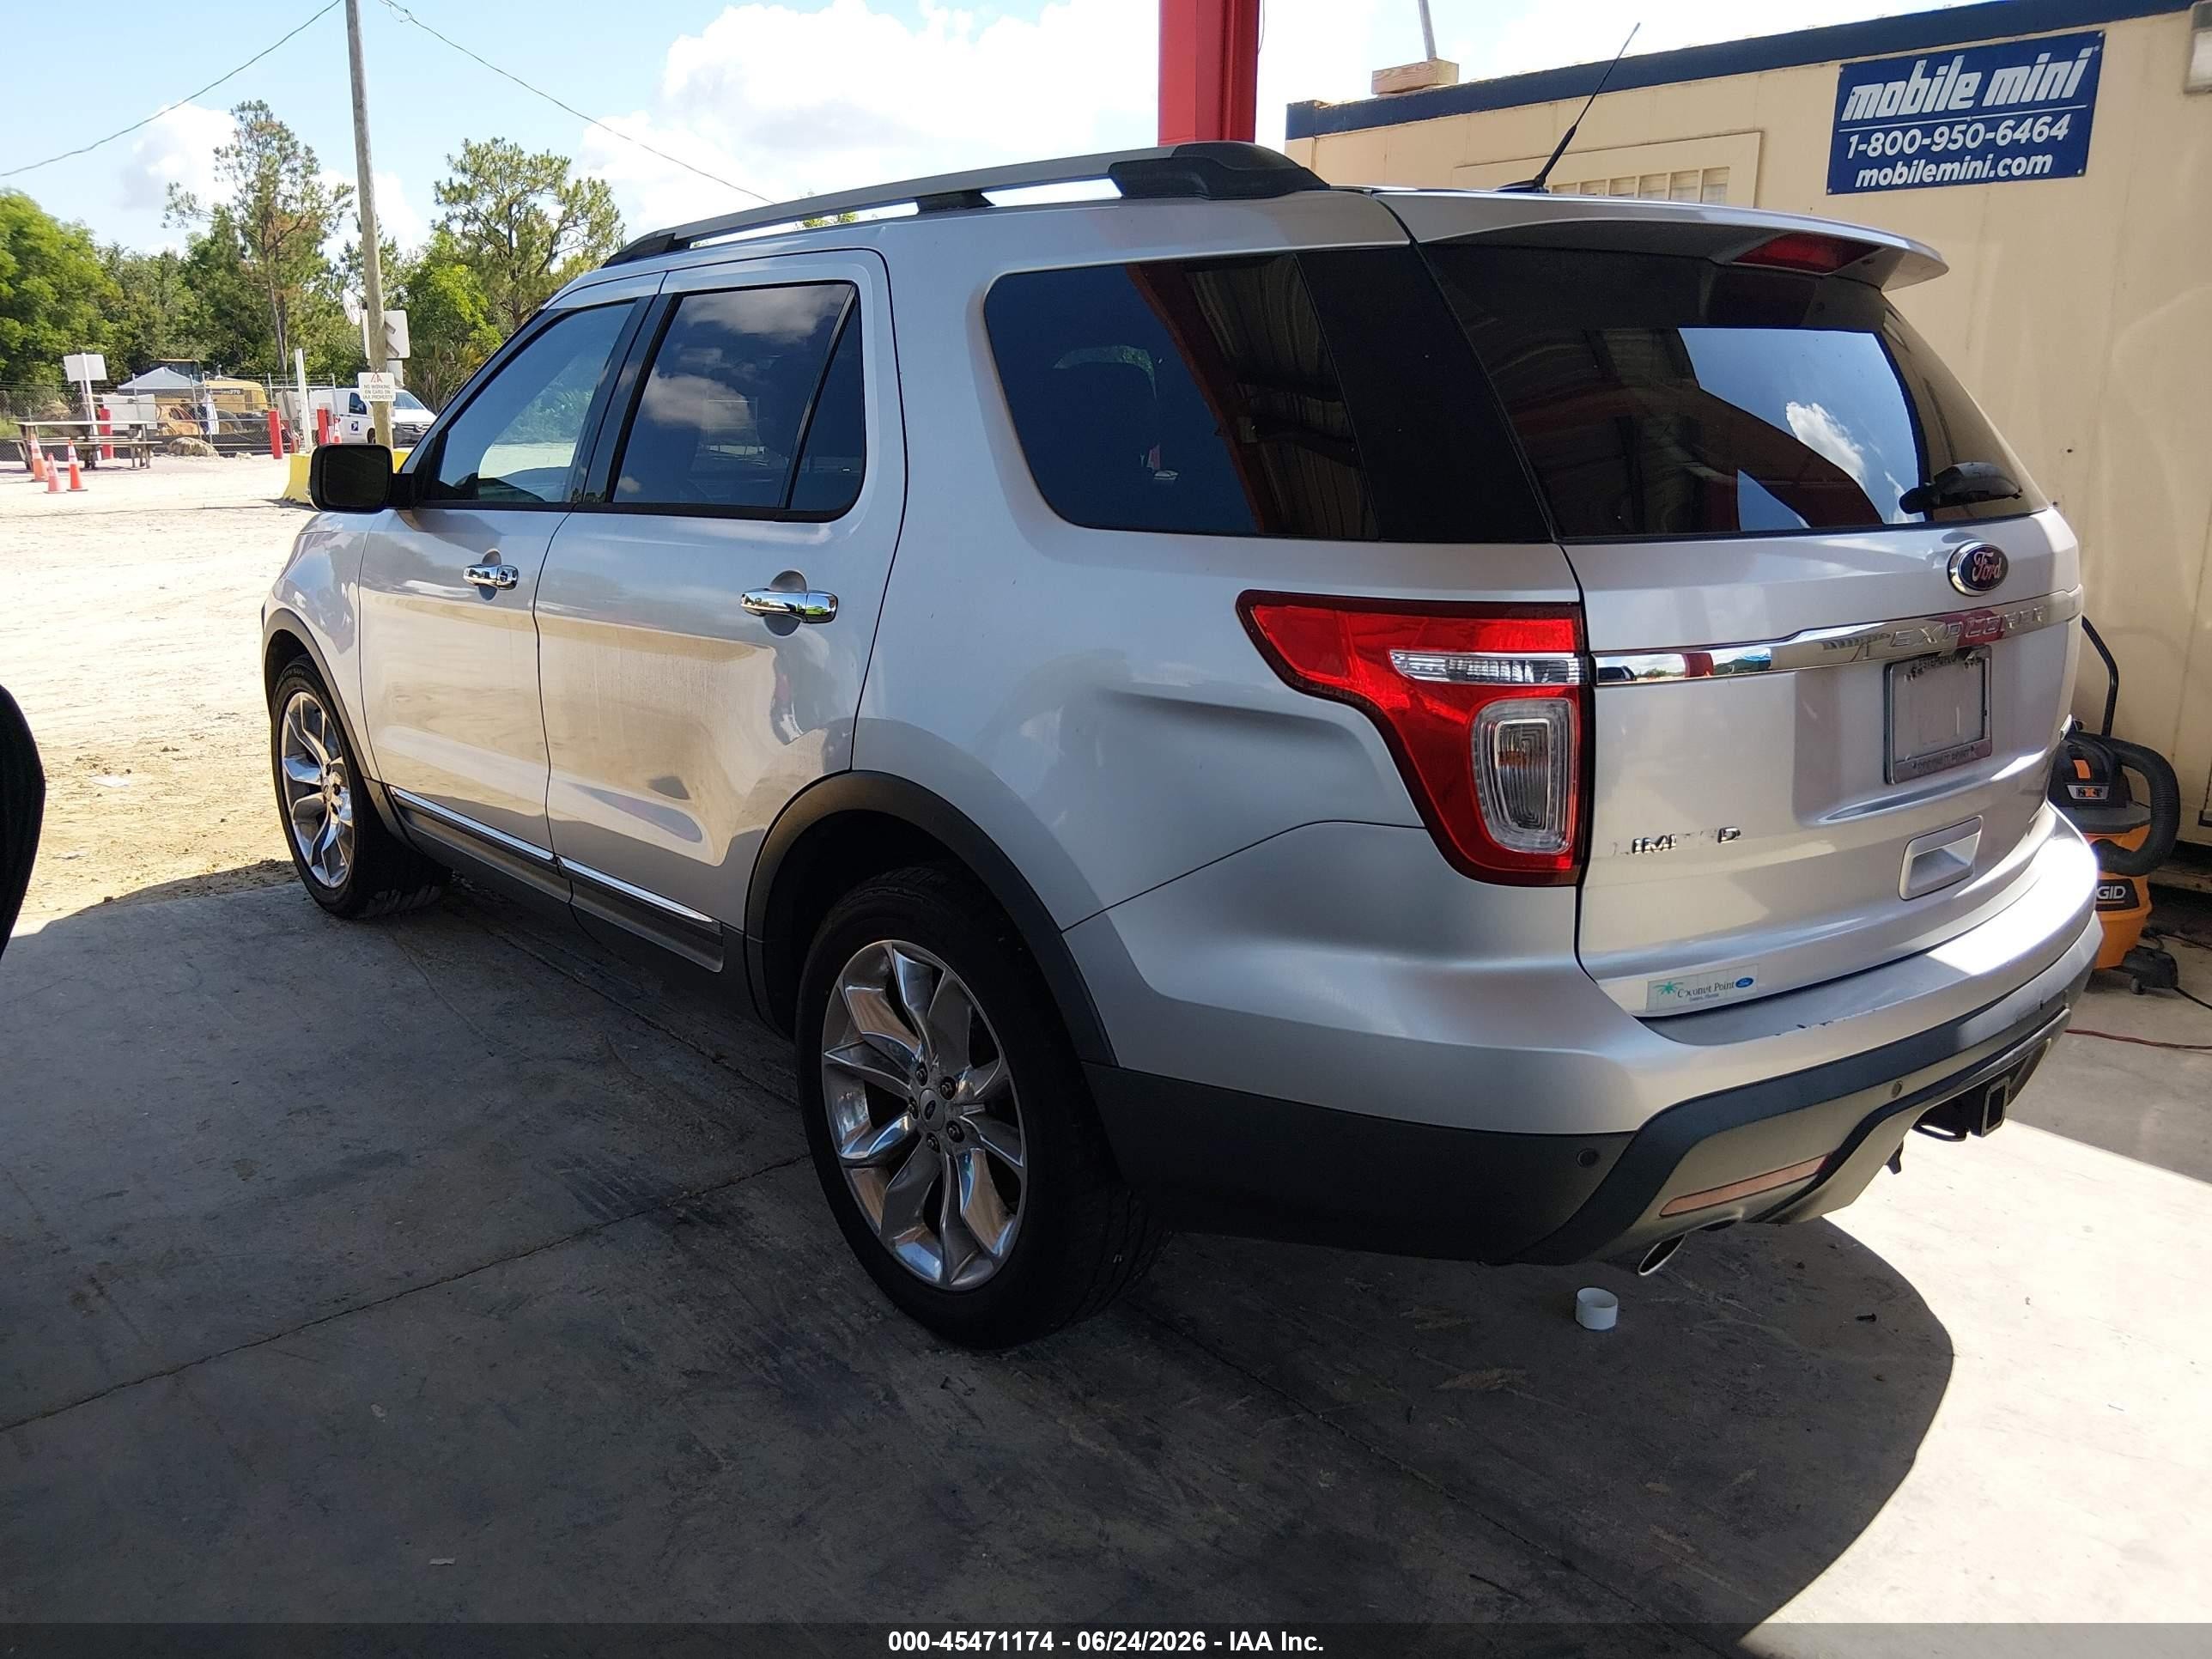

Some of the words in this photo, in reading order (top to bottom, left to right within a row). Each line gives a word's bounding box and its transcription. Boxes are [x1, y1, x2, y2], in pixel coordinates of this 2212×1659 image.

[1841, 55, 1982, 121] mobile
[1982, 46, 2094, 107] mini
[1847, 113, 2072, 159] 1-800-950-6464
[1855, 153, 2053, 188] mobilemini.com
[1972, 551, 2002, 582] Ford
[1714, 981, 1735, 992] Point
